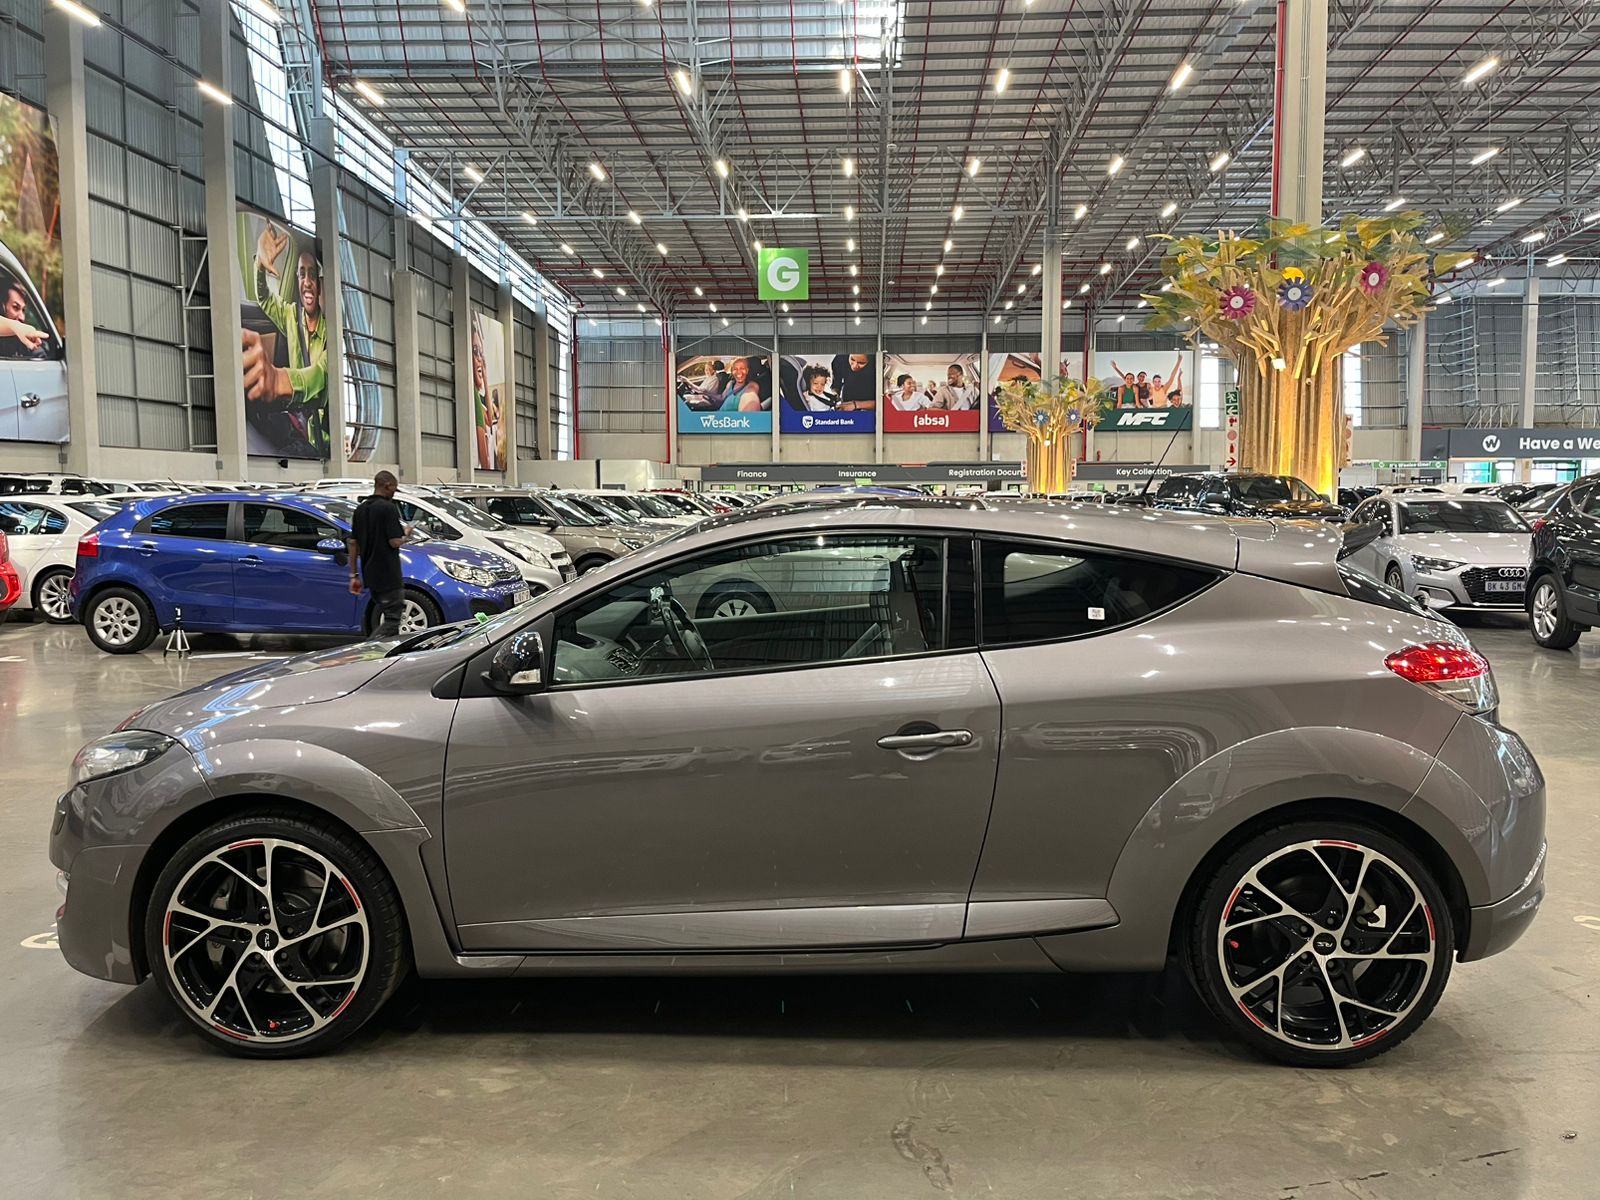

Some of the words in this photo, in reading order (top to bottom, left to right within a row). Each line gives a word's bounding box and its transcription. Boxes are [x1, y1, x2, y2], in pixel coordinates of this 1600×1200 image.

[767, 256, 800, 292] G
[700, 415, 750, 428] WesBank
[815, 418, 840, 426] Standard
[840, 418, 855, 426] Bank
[1116, 412, 1170, 426] MFC
[1519, 437, 1561, 450] Have
[1563, 439, 1574, 450] a
[737, 470, 768, 478] Finance
[948, 469, 996, 478] Registration
[1116, 468, 1132, 477] Key
[1132, 467, 1173, 476] Collection
